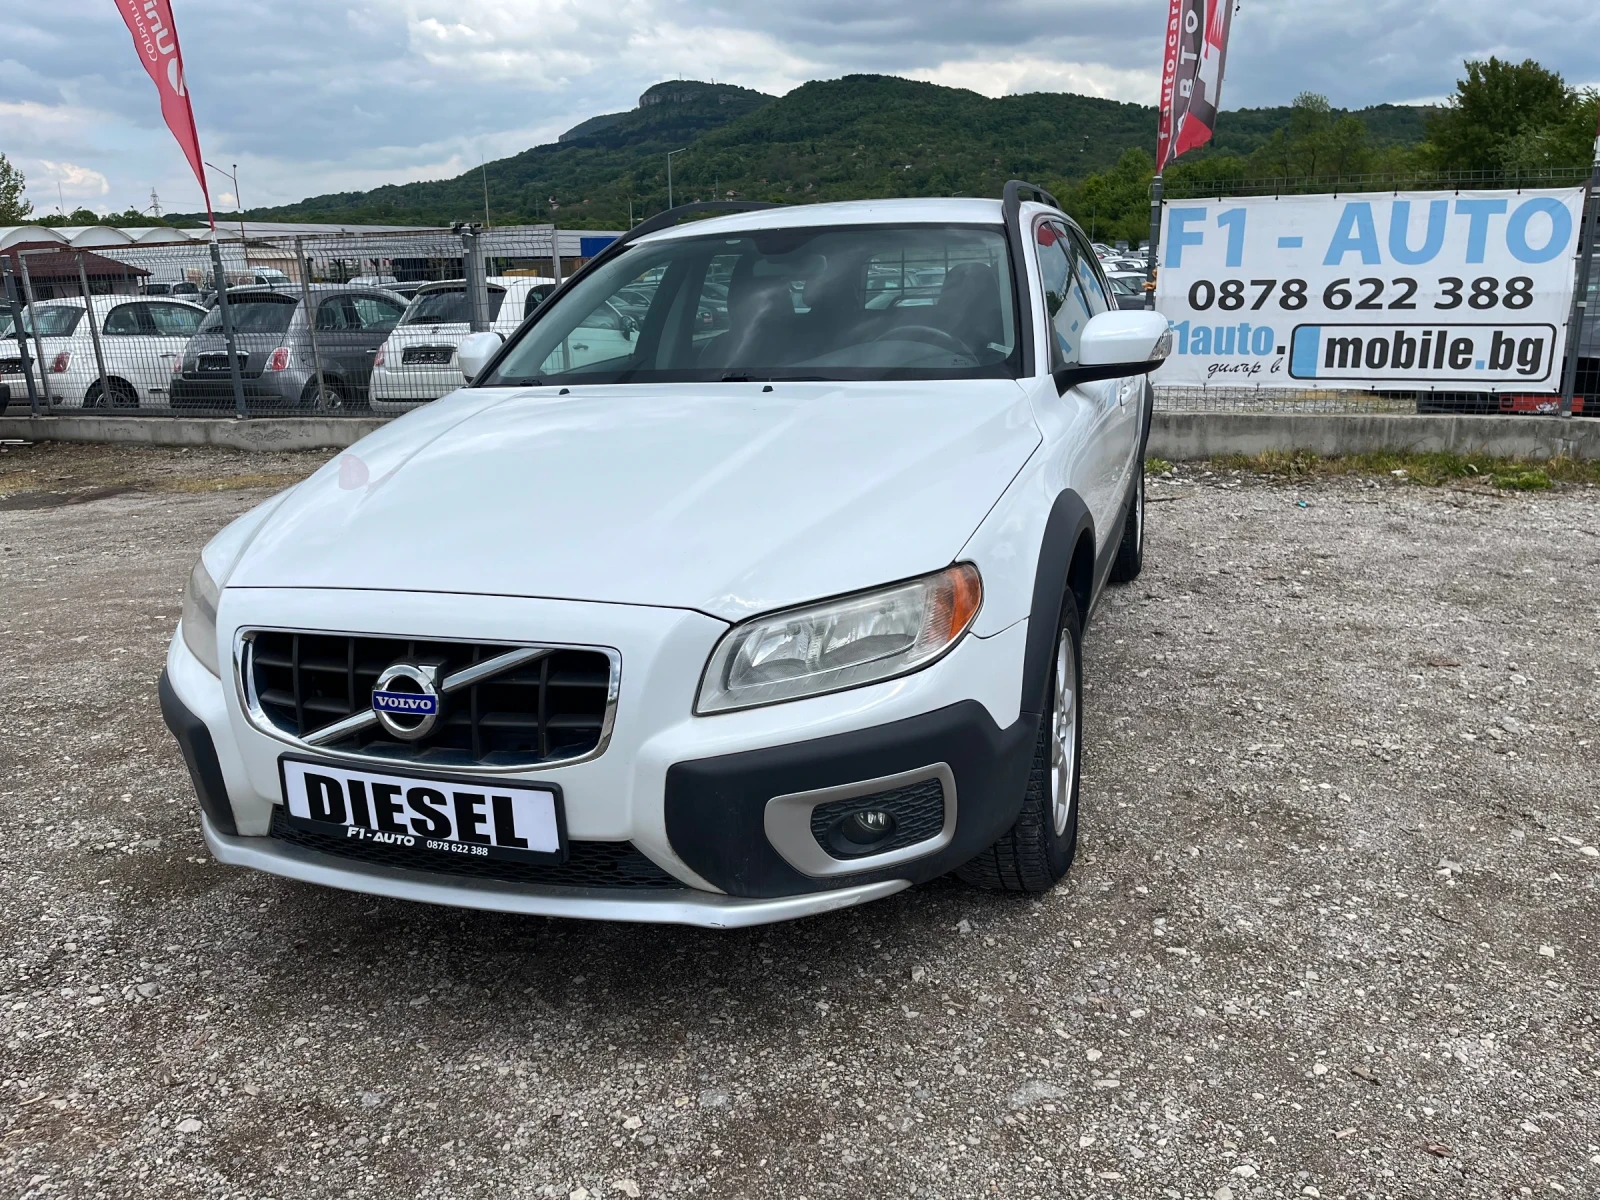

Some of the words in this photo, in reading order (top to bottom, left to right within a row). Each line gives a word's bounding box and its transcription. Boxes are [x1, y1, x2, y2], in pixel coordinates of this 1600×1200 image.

[1165, 207, 1247, 269] F1
[1322, 197, 1573, 267] AUTO
[1188, 278, 1308, 311] 0878
[1322, 277, 1417, 311] 622
[1433, 276, 1534, 310] 388
[1207, 361, 1261, 379] дилър
[1270, 357, 1284, 374] в
[1324, 330, 1545, 374] mobile.bg
[375, 695, 432, 710] VOLVO
[303, 772, 528, 849] DIESEL
[346, 826, 415, 847] F1-AUTO
[426, 839, 450, 851] 0878
[451, 843, 469, 854] 622
[470, 846, 489, 857] 388
